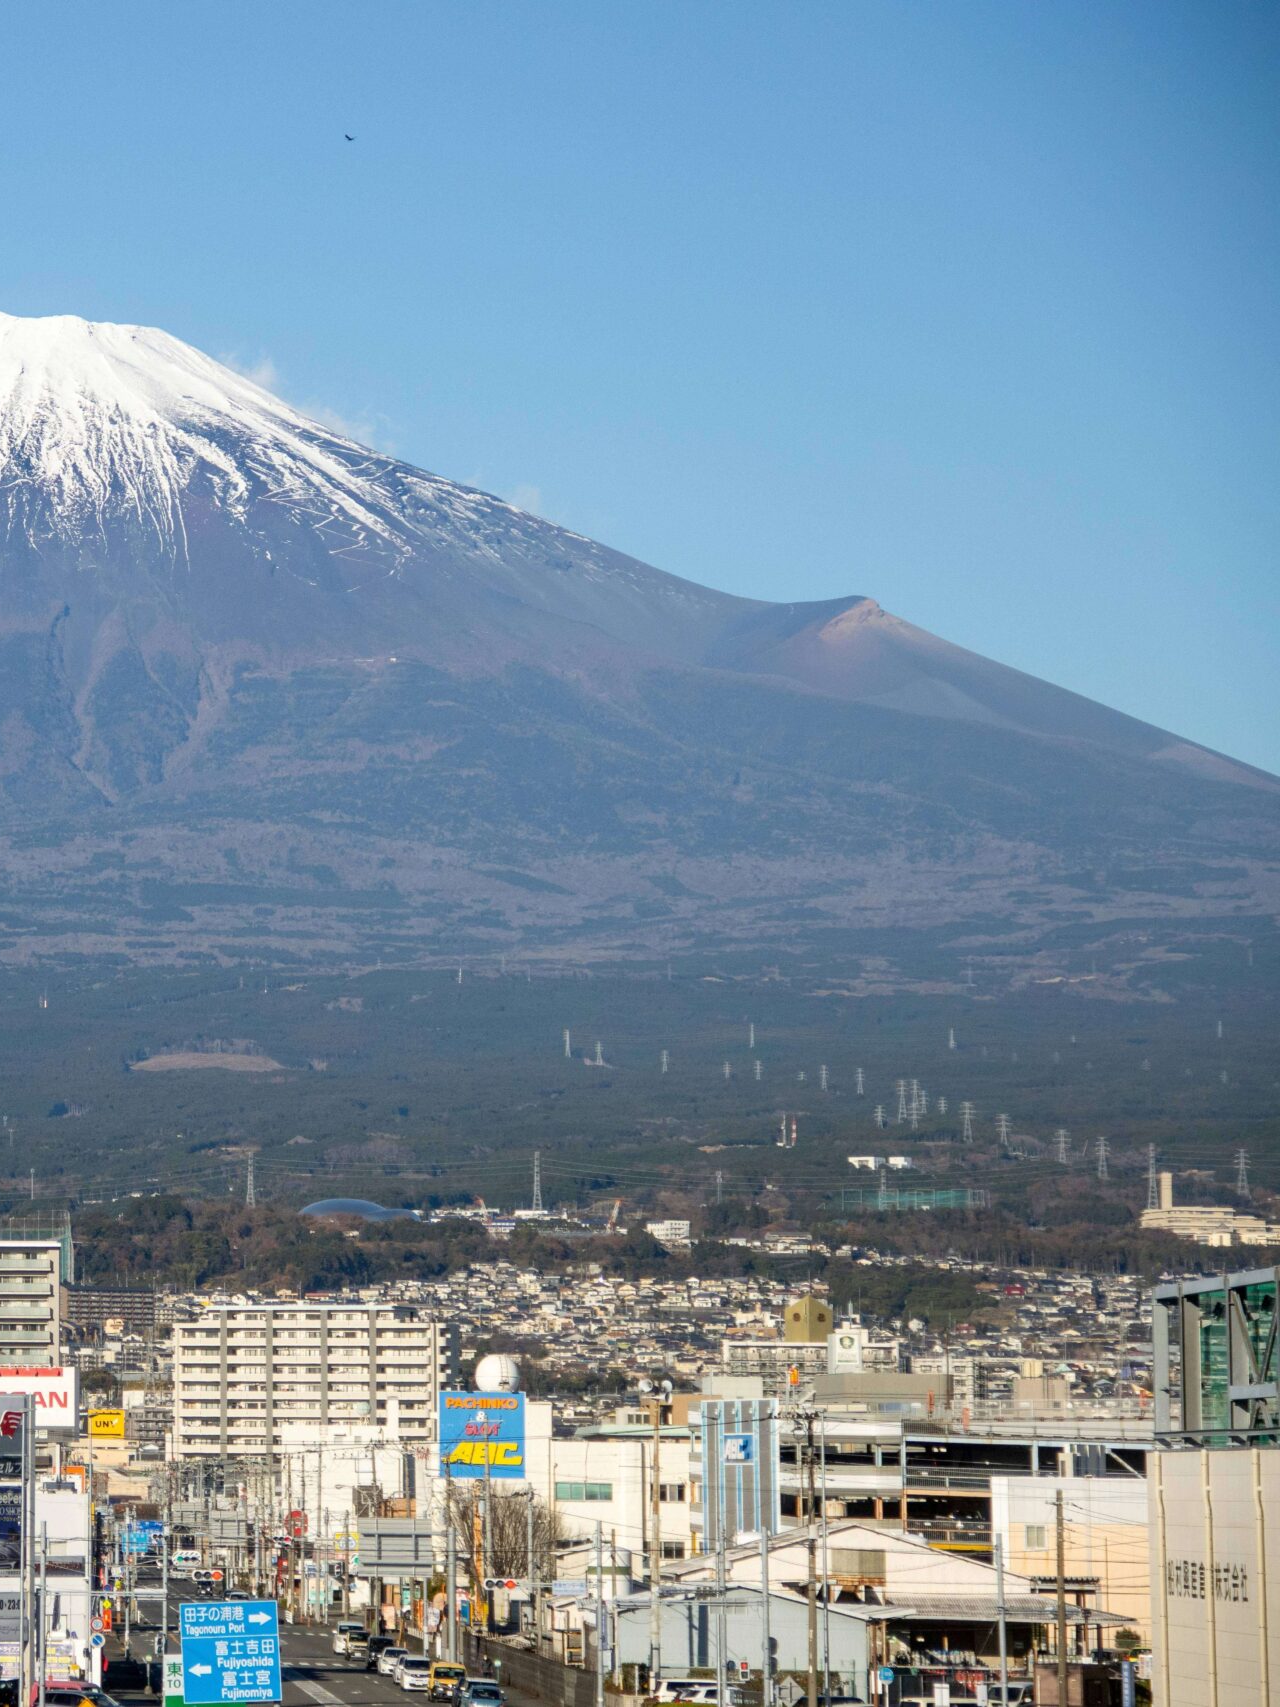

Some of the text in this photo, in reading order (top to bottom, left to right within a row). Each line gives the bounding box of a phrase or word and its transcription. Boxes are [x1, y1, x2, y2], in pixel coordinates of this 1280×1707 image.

[446, 1397, 518, 1410] PACHINKO
[465, 1423, 500, 1436] SLOT
[444, 1441, 523, 1466] ABC
[184, 1606, 244, 1622] 田子の浦港
[184, 1623, 245, 1636] Tagonoura Port
[215, 1639, 274, 1656] 富士吉田
[217, 1656, 274, 1669] Fujiyoshida
[222, 1670, 271, 1686] 富士宮
[221, 1687, 273, 1701] Fujinomiya
